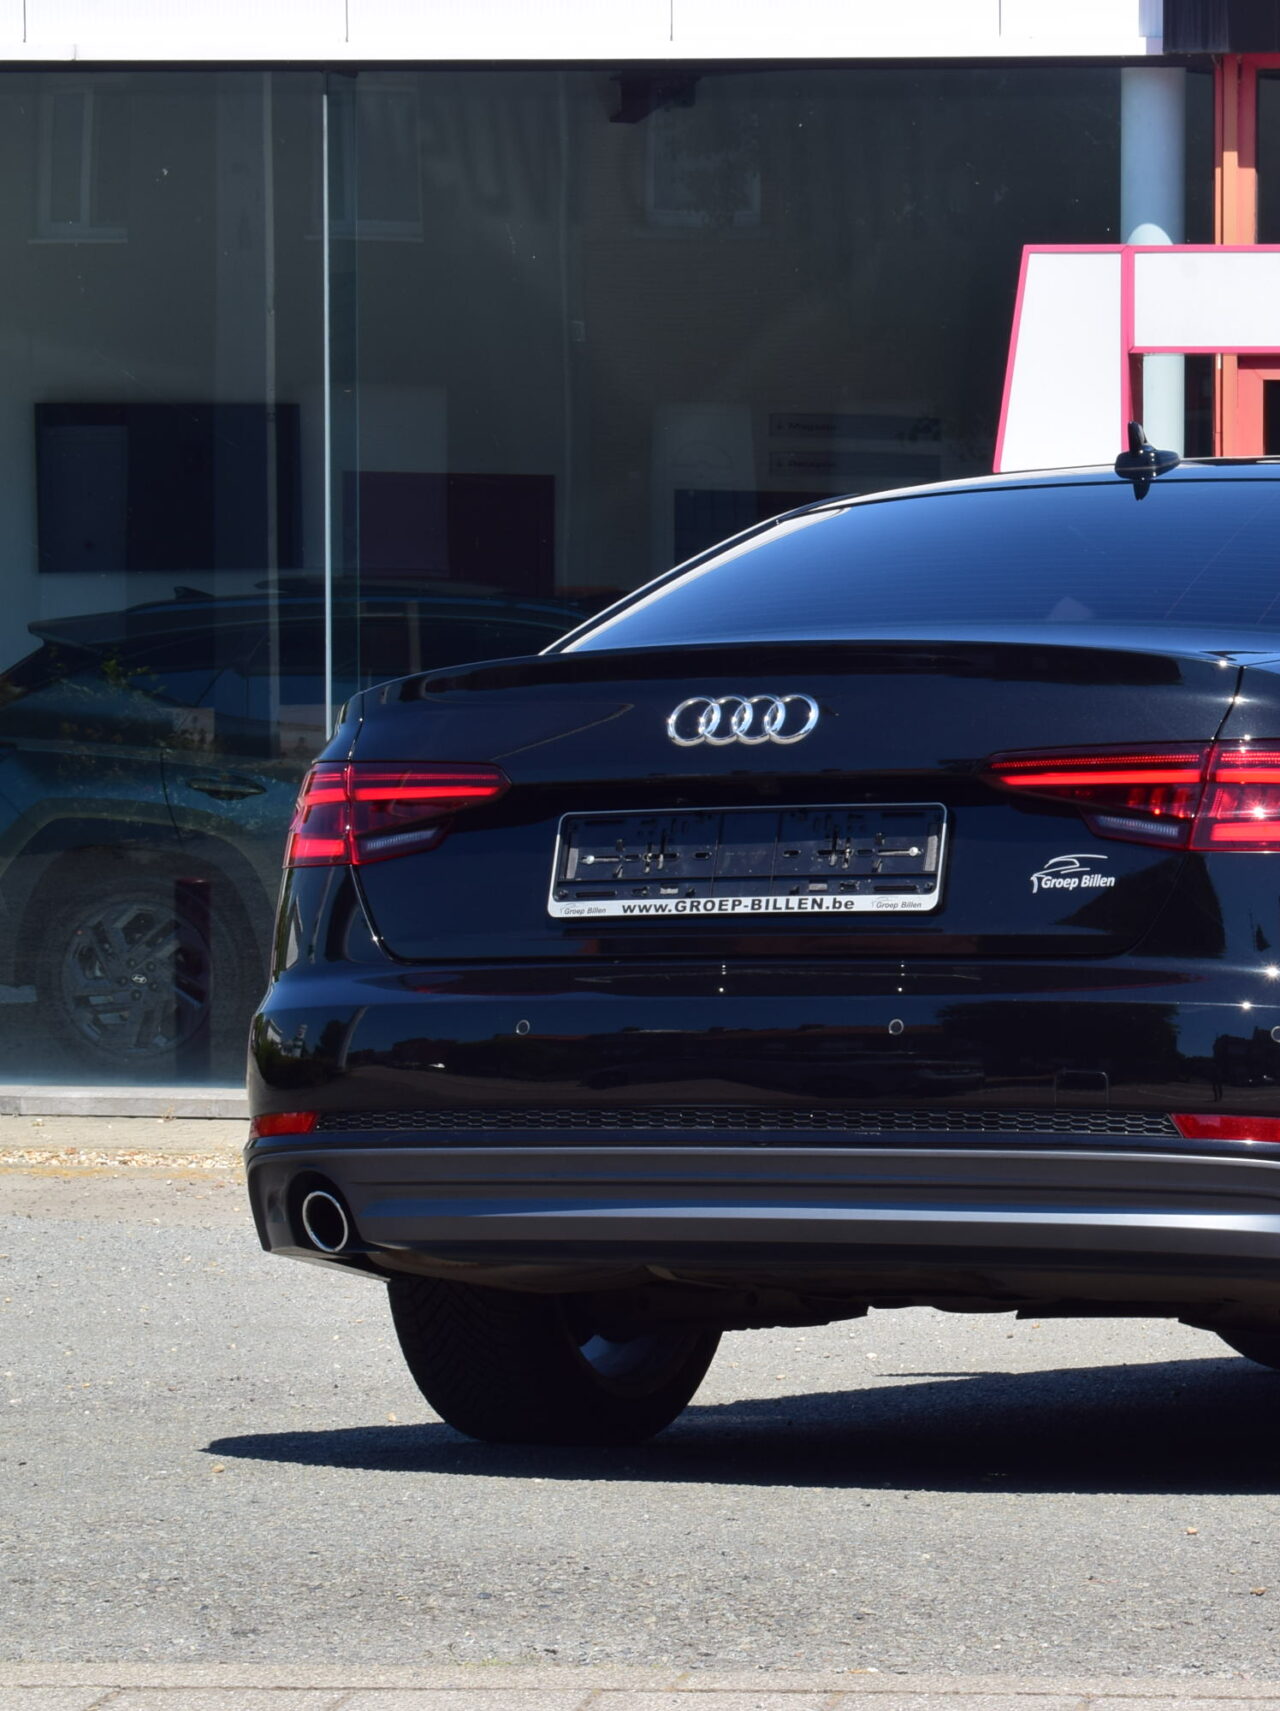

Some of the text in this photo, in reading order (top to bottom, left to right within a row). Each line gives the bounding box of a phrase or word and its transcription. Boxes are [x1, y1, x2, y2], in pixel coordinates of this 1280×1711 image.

[1041, 874, 1115, 891] Groep Billen
[563, 907, 585, 915] Groep
[621, 897, 855, 914] www.GROEP-BILLEN.be
[876, 901, 922, 910] Groep Billen
